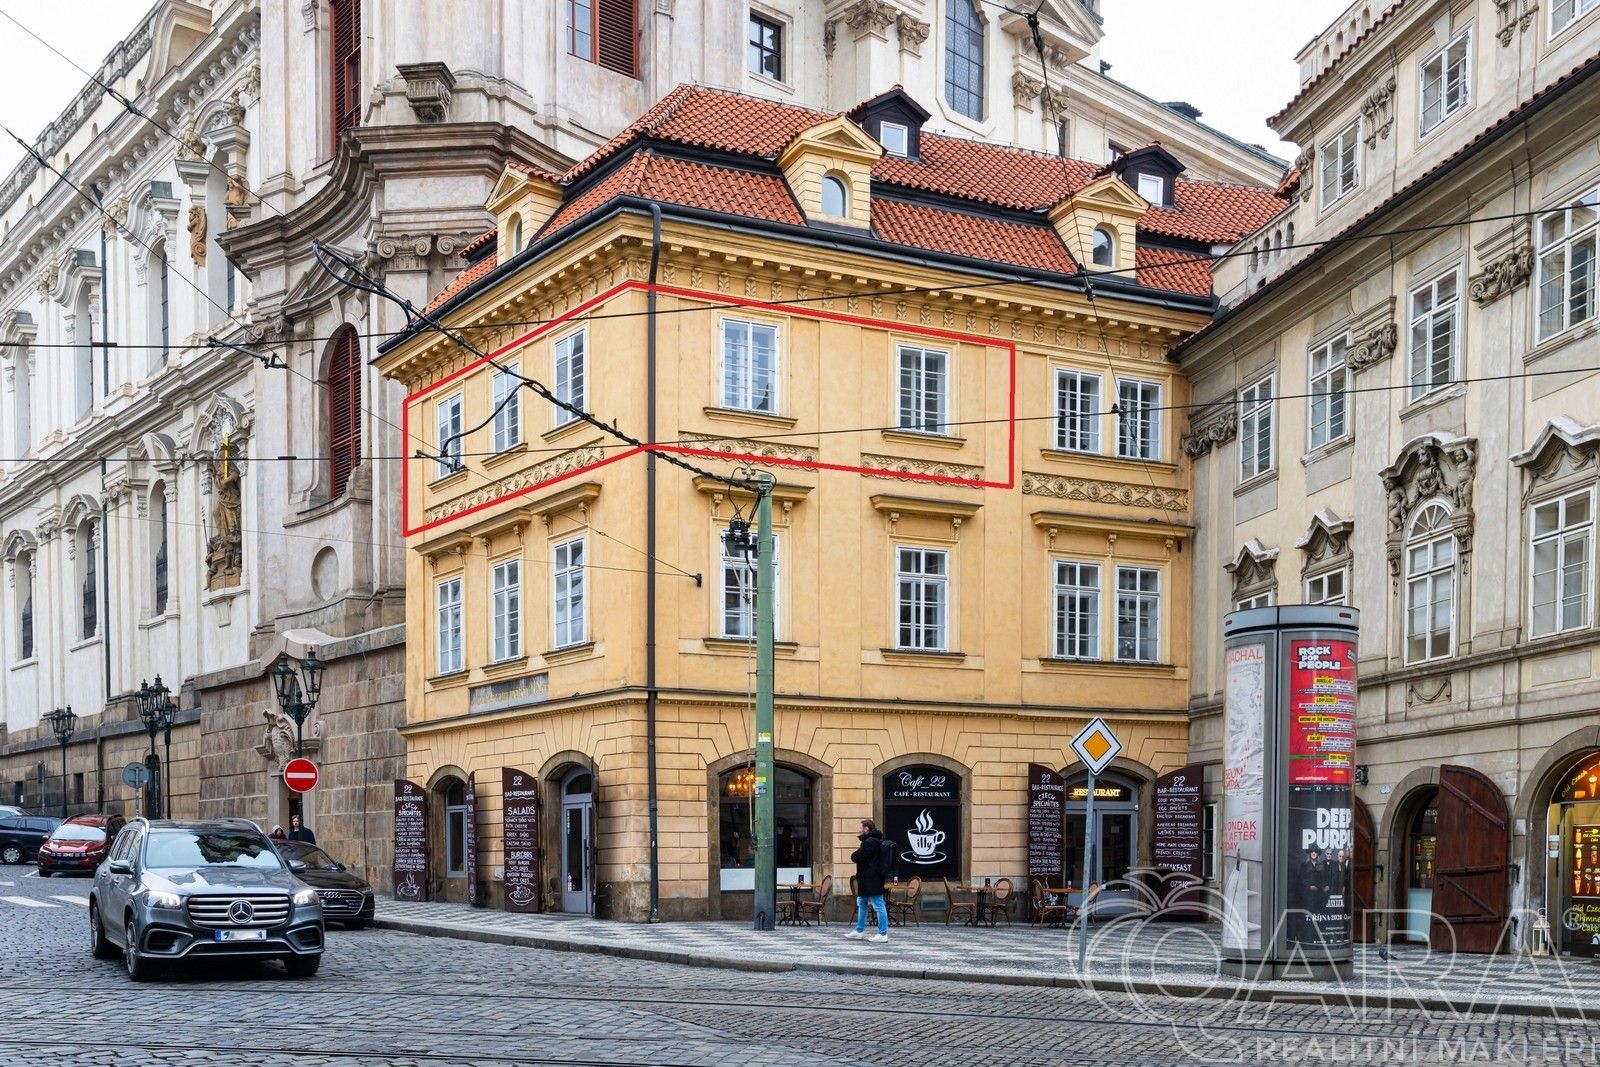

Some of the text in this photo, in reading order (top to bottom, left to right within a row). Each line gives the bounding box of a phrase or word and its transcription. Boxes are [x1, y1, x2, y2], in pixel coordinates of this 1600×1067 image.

[1298, 646, 1330, 656] ROCK
[1298, 661, 1341, 670] PEOPLE
[513, 775, 523, 786] 22
[1041, 774, 1051, 783] 22
[1173, 775, 1186, 787] 22
[403, 784, 413, 794] 22
[1073, 788, 1121, 797] RESAURANT
[507, 806, 536, 816] SALADS
[1316, 808, 1352, 828] DEEP
[1302, 829, 1354, 849] PURPL
